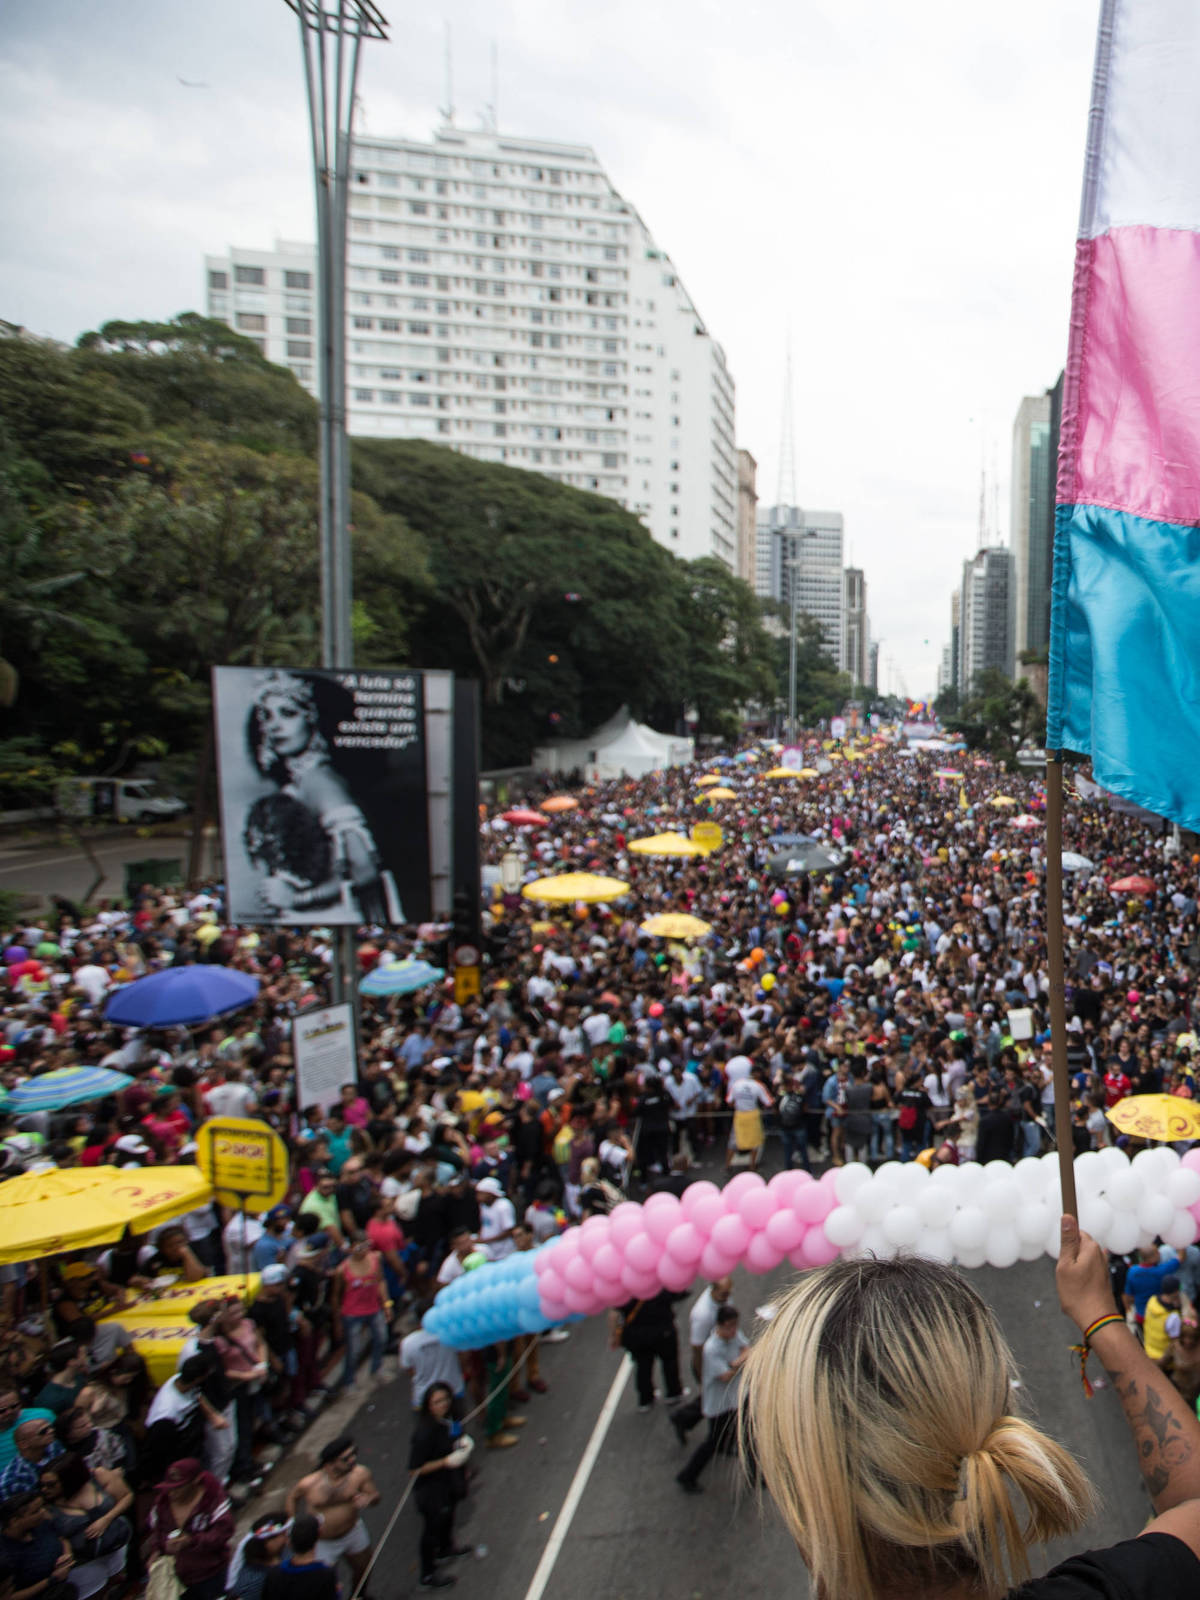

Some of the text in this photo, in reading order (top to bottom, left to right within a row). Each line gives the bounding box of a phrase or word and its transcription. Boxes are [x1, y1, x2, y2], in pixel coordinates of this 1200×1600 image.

[353, 691, 415, 705] termina
[354, 706, 416, 721] quando
[338, 720, 416, 734] existe um
